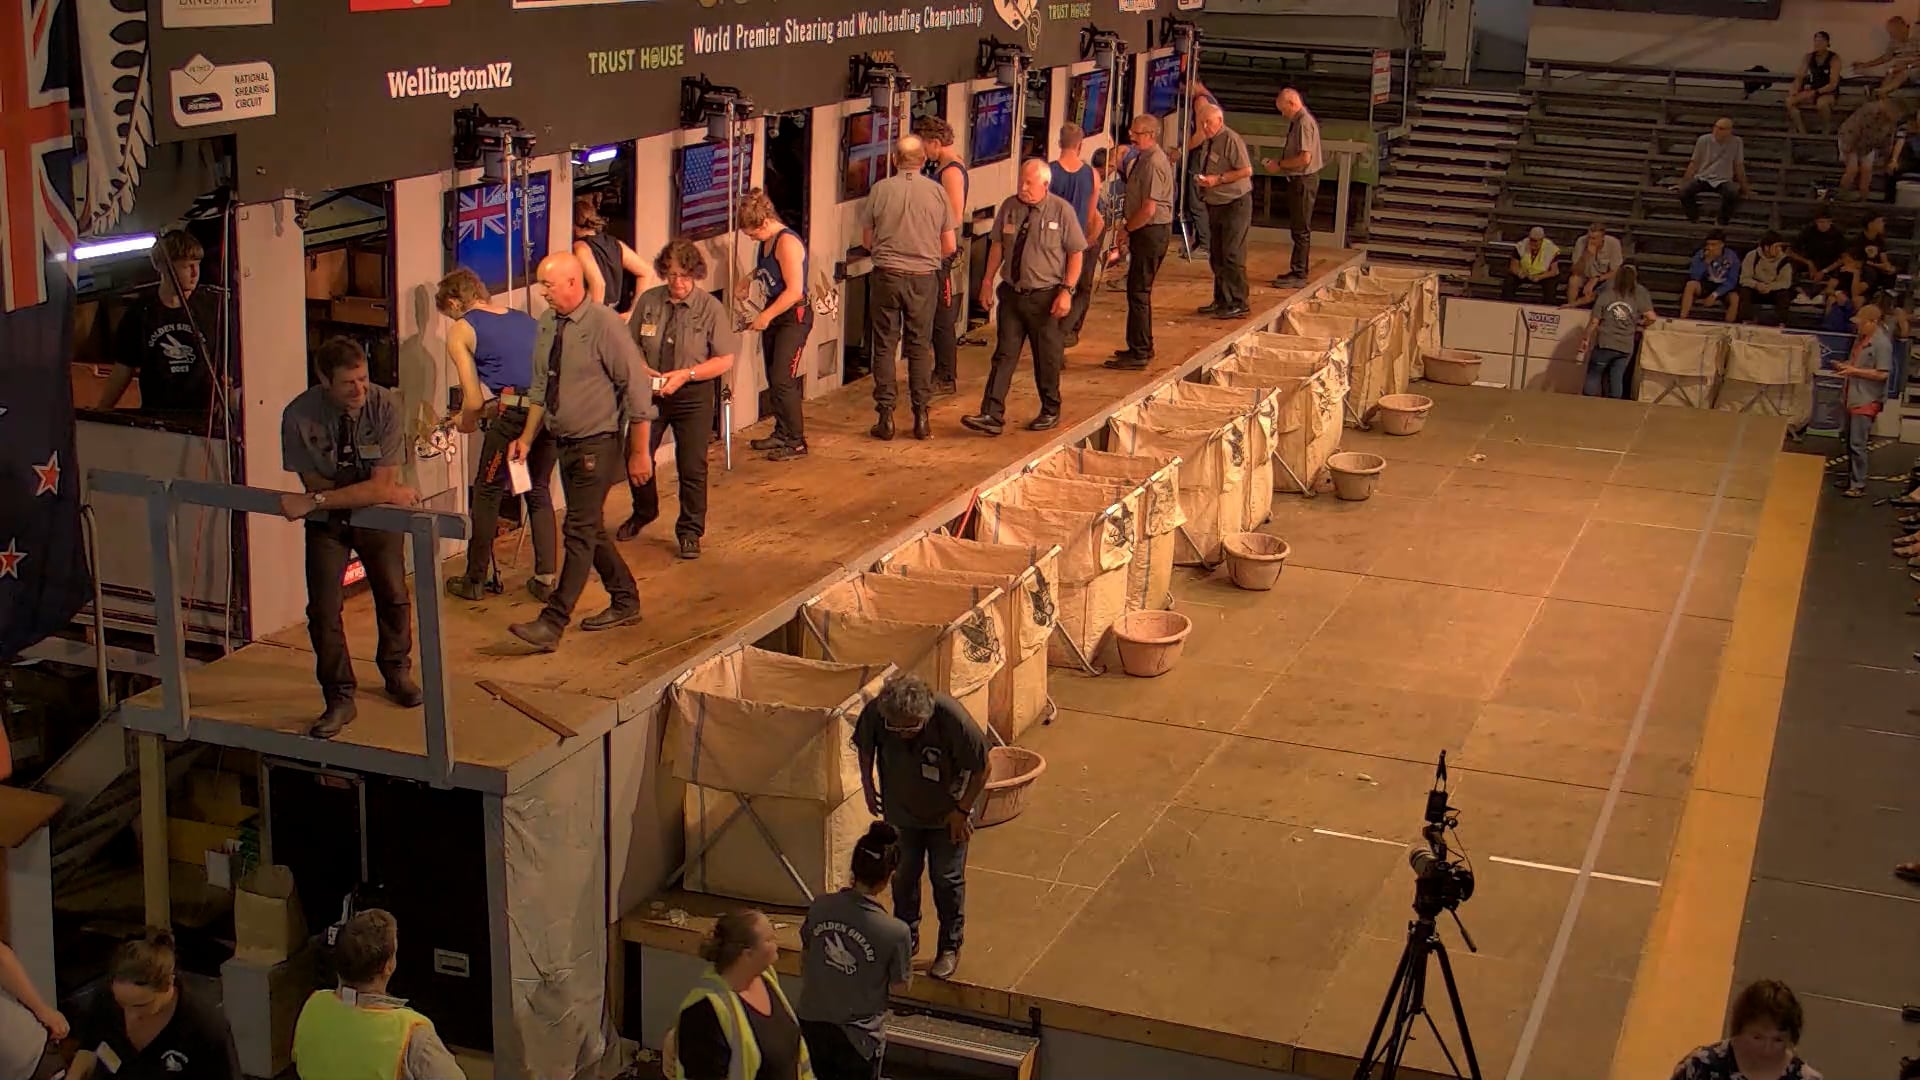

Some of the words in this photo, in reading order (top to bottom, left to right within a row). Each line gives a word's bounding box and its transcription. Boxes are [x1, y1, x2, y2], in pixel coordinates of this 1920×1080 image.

[1048, 4, 1069, 20] TRUST
[694, 24, 731, 54] World
[736, 21, 781, 49] Premier
[785, 17, 833, 44] Shearing
[836, 14, 855, 38] and
[858, 9, 921, 34] Woolhandling
[923, 3, 983, 30] Championship
[588, 49, 636, 75] TRUST
[640, 44, 684, 69] HOUSE
[234, 72, 269, 84] NATIONAL
[387, 62, 513, 99] WellingtonNZ
[235, 84, 270, 97] SHEARING
[235, 97, 262, 109] CIRCUIT
[1528, 313, 1559, 324] NOTICE
[814, 921, 847, 936] GOLDEN
[848, 928, 875, 961] SHEARS
